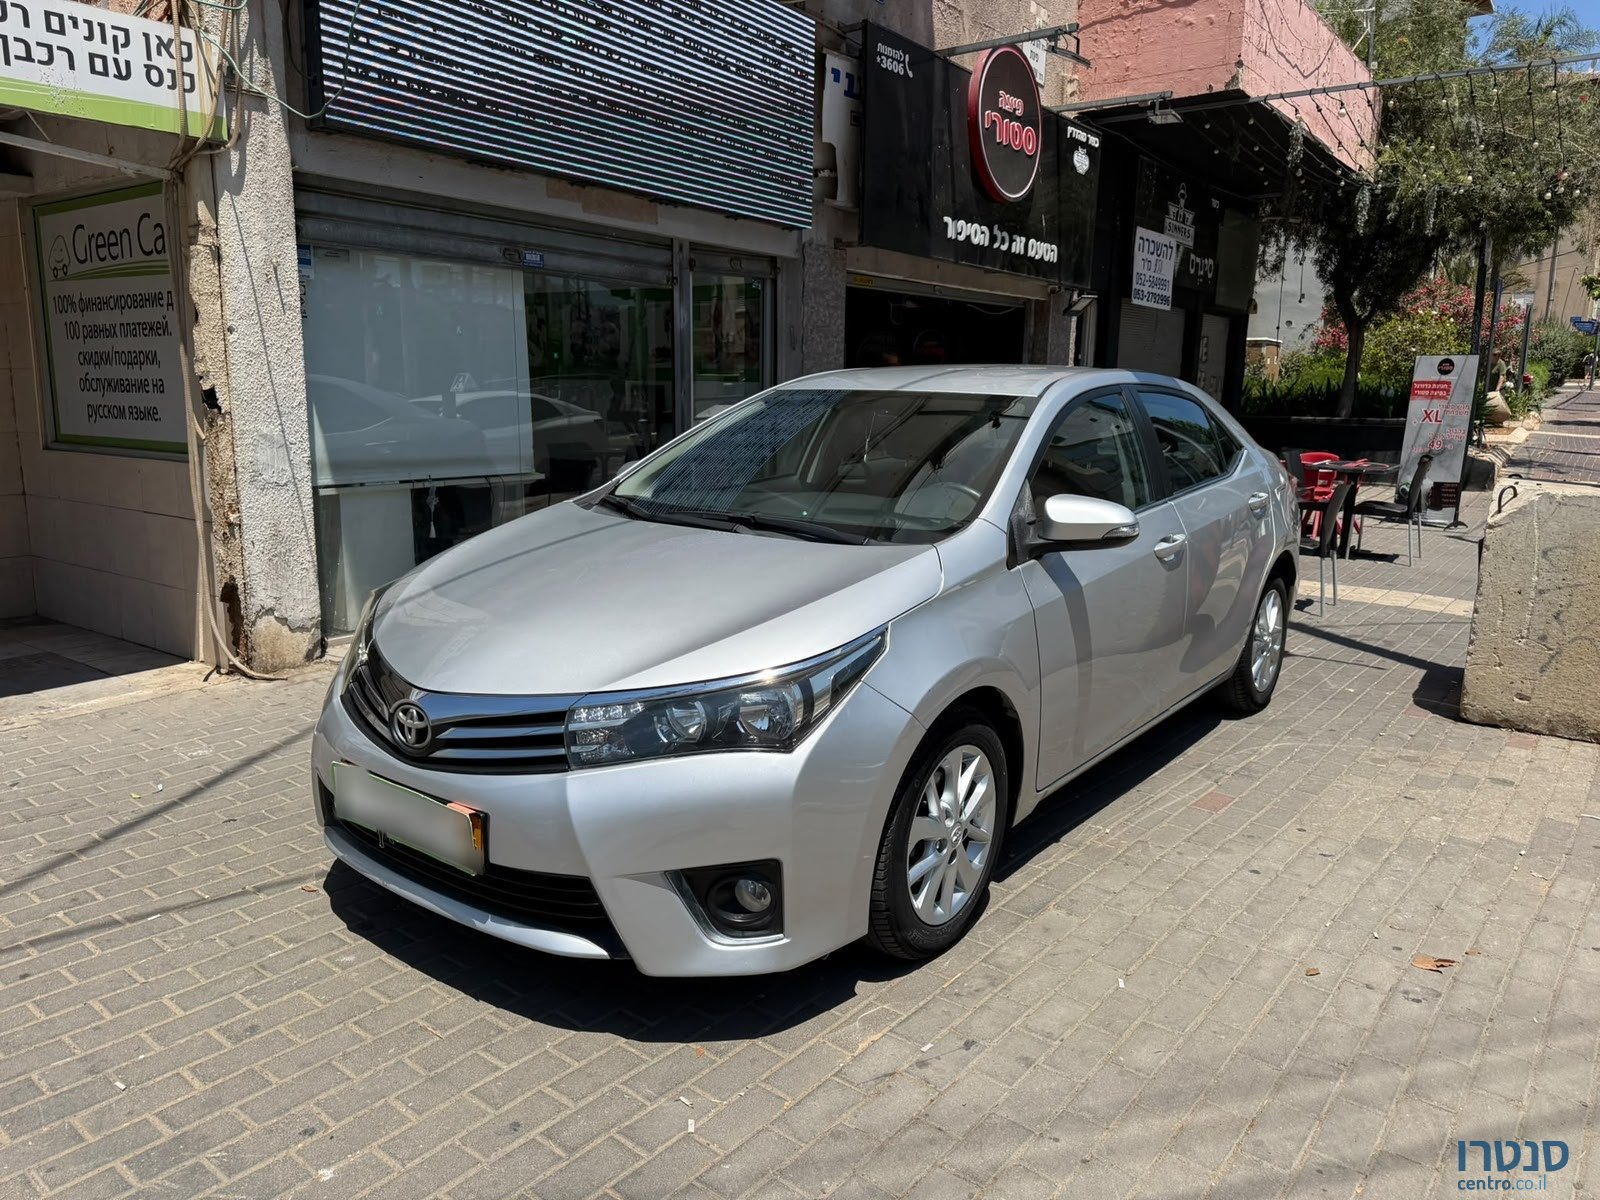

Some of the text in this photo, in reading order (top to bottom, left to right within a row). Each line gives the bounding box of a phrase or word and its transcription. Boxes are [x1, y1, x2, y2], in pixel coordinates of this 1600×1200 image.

[44, 10, 131, 55] קונים
[142, 32, 193, 62] כאן
[877, 43, 904, 61] להזמנות
[88, 52, 132, 81] עם
[143, 63, 196, 93] כנס
[999, 90, 1024, 116] פיצה
[985, 110, 1036, 155] סטורי
[943, 216, 1058, 263] הטעם זה כל הסיפור
[1167, 221, 1191, 239] SINNERS
[73, 224, 133, 264] Green
[1138, 236, 1174, 261] להשכרה
[53, 293, 78, 314] 100%
[79, 291, 164, 318] финансирование
[64, 315, 172, 344] 100 равных платежей.
[78, 345, 161, 371] скидки/подарки,
[79, 372, 165, 397] обслуживание на
[87, 403, 161, 423] русском языке.
[1421, 409, 1443, 423] XL
[1428, 440, 1442, 449] 49
